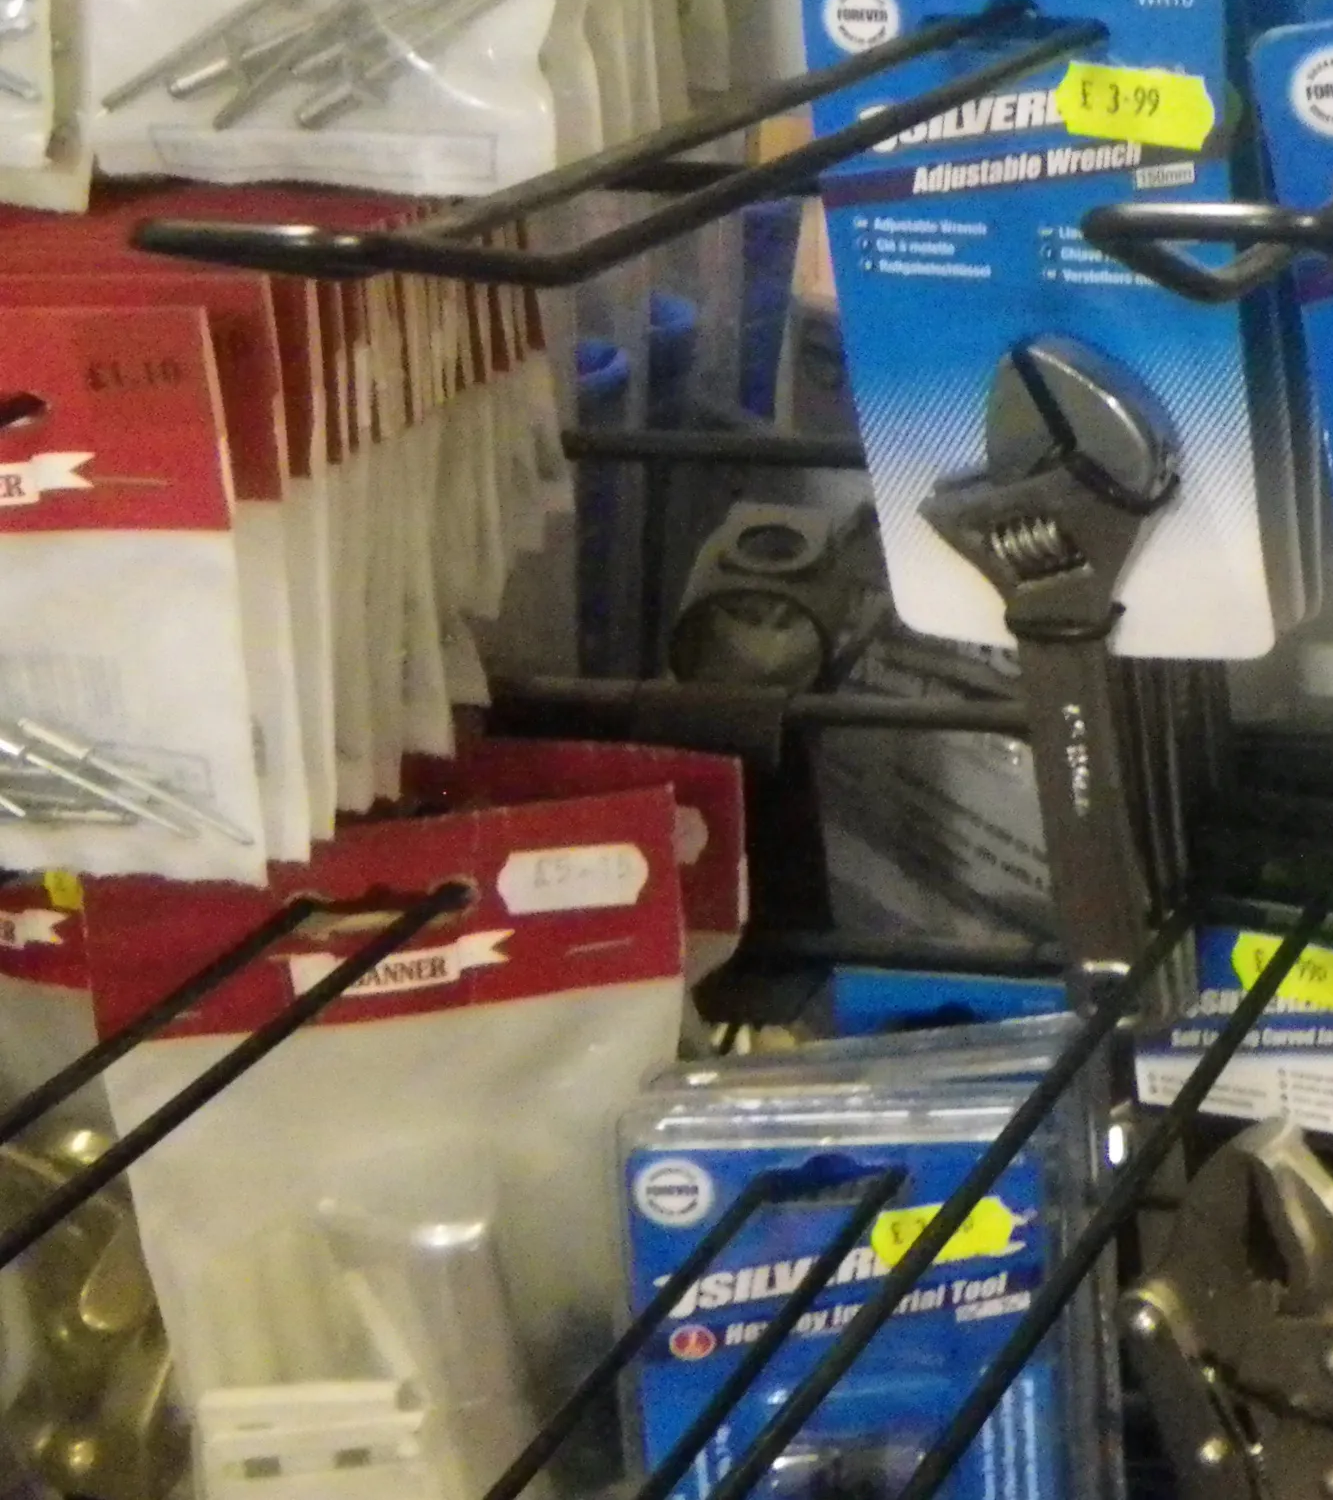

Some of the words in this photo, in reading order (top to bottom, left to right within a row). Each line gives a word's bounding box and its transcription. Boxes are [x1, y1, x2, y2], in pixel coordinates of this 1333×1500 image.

[836, 7, 888, 24] FOREVER
[912, 152, 1043, 195] Adjustable
[1047, 141, 1142, 179] Wrench
[356, 955, 448, 988] ANNER
[951, 1272, 1008, 1304] Tool
